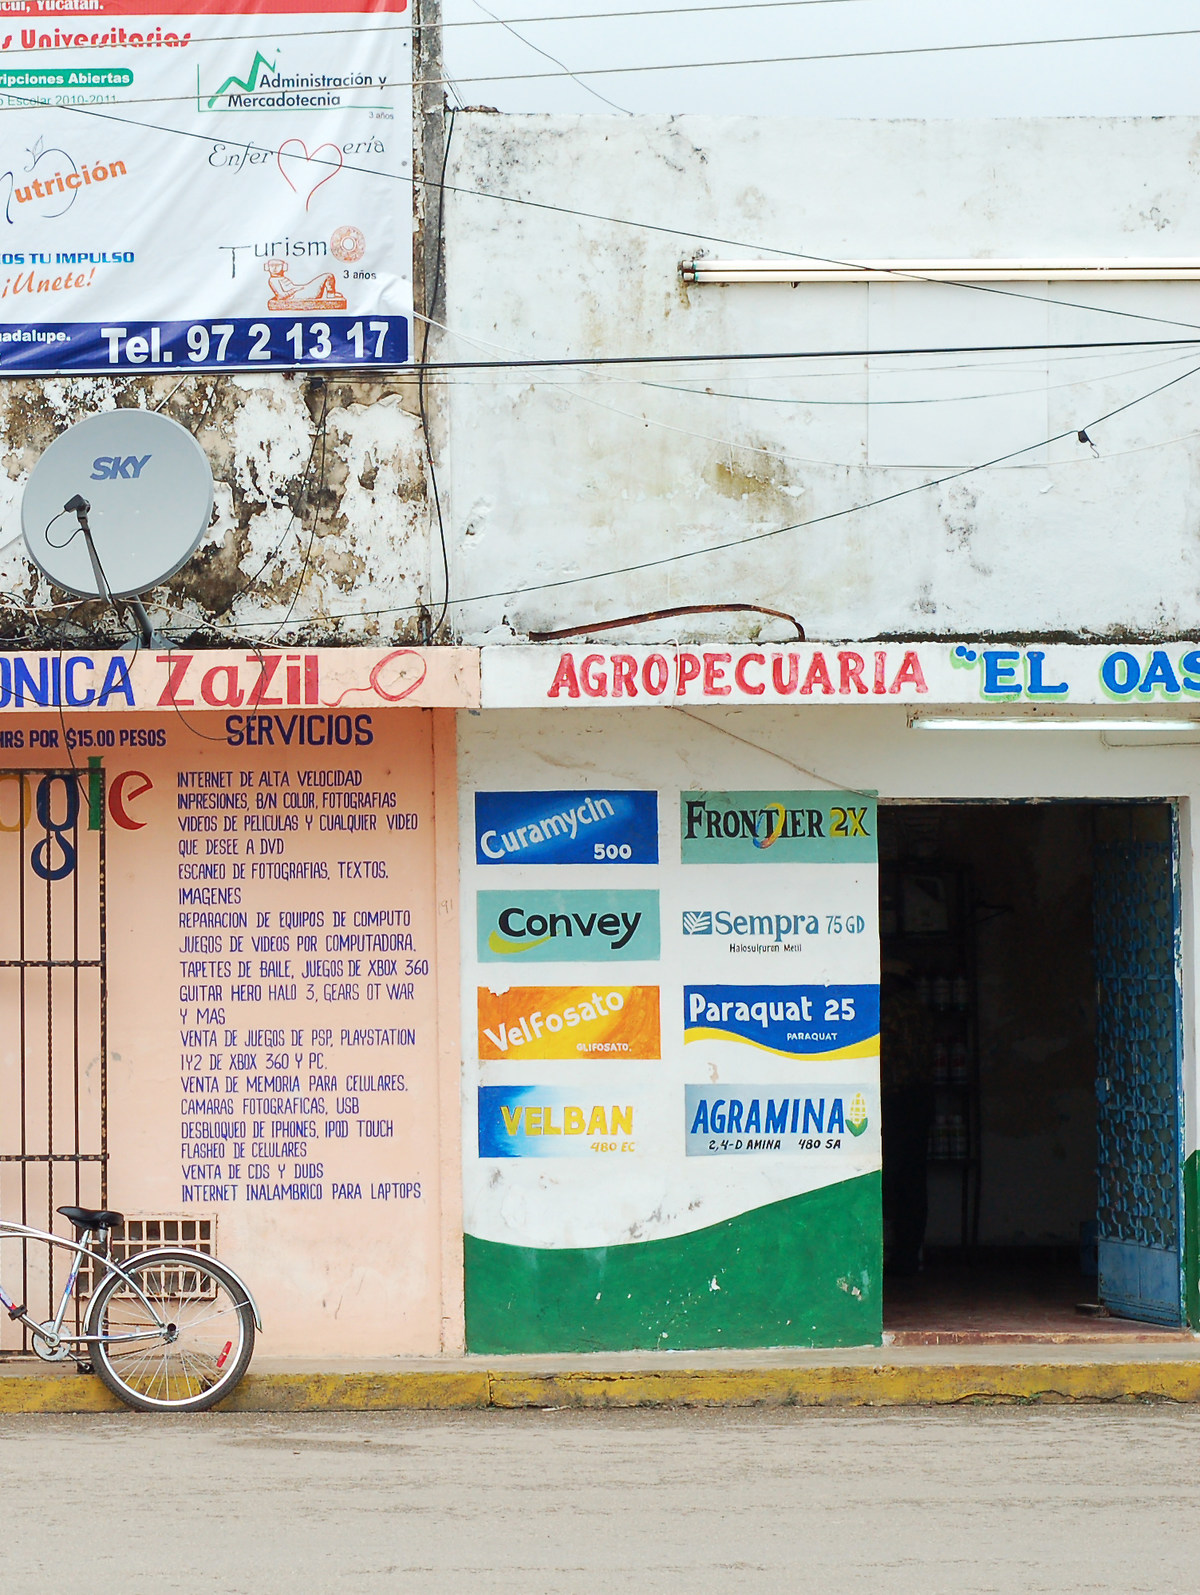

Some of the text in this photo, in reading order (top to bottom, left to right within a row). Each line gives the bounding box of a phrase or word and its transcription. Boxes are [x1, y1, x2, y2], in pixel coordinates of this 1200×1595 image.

[21, 27, 192, 49] Universitarias
[68, 72, 130, 84] Abiertas
[259, 73, 387, 90] Administración y
[7, 95, 51, 107] Escolar
[228, 93, 341, 108] Mercadotecnia
[29, 253, 51, 265] TU
[56, 251, 135, 264] IMPULSO
[343, 269, 377, 280] 3 años
[100, 321, 389, 364] Tel. 97 2 13 17
[90, 455, 152, 481] SKY
[546, 650, 929, 698] AGROPECUARIA
[29, 730, 59, 748] POR
[66, 728, 116, 750] $15.00
[119, 728, 167, 747] PESOS
[225, 714, 373, 746] SERVICIOS
[177, 770, 363, 788] INTERNET DE ALTA VELOCIDAD
[178, 813, 418, 834] VIDEOS DE PELICULAS Y CUALQUIER VIDEO
[480, 795, 632, 860] Curamycin 500
[830, 807, 871, 838] 2X
[178, 838, 284, 858] QUE DESEE A DVD
[179, 887, 242, 905] IMAGENES
[179, 910, 411, 929] REPARACION DE EQUIPOS DE COMPUTO
[498, 907, 642, 950] Convey
[715, 910, 866, 942] Sempra 75 GD
[179, 934, 416, 953] JUEGOS DE VIDEOS POR COMPUTADORA.
[179, 985, 223, 1002] GUITAR
[231, 984, 262, 1001] HERO
[268, 984, 297, 1001] HALO
[306, 983, 319, 1003] 3,
[323, 983, 360, 1002] GEARS
[385, 983, 415, 1000] WAR
[179, 1007, 226, 1025] Y MAS
[688, 993, 855, 1028] Paraquat 25
[786, 1032, 838, 1041] PARAQUAT
[180, 1075, 408, 1093] VENTA DE MEMORIA PARA CELULARES.
[500, 1105, 633, 1136] VELBAN
[691, 1098, 845, 1135] AGRAMINA
[181, 1142, 308, 1159] FLASHEO DE CELULARES
[589, 1142, 636, 1153] 480 EC
[708, 1138, 842, 1152] 2,4-D AMINA 480 SA
[182, 1182, 422, 1202] INTERNET INALAMBRICO PARA LAPTOPS
